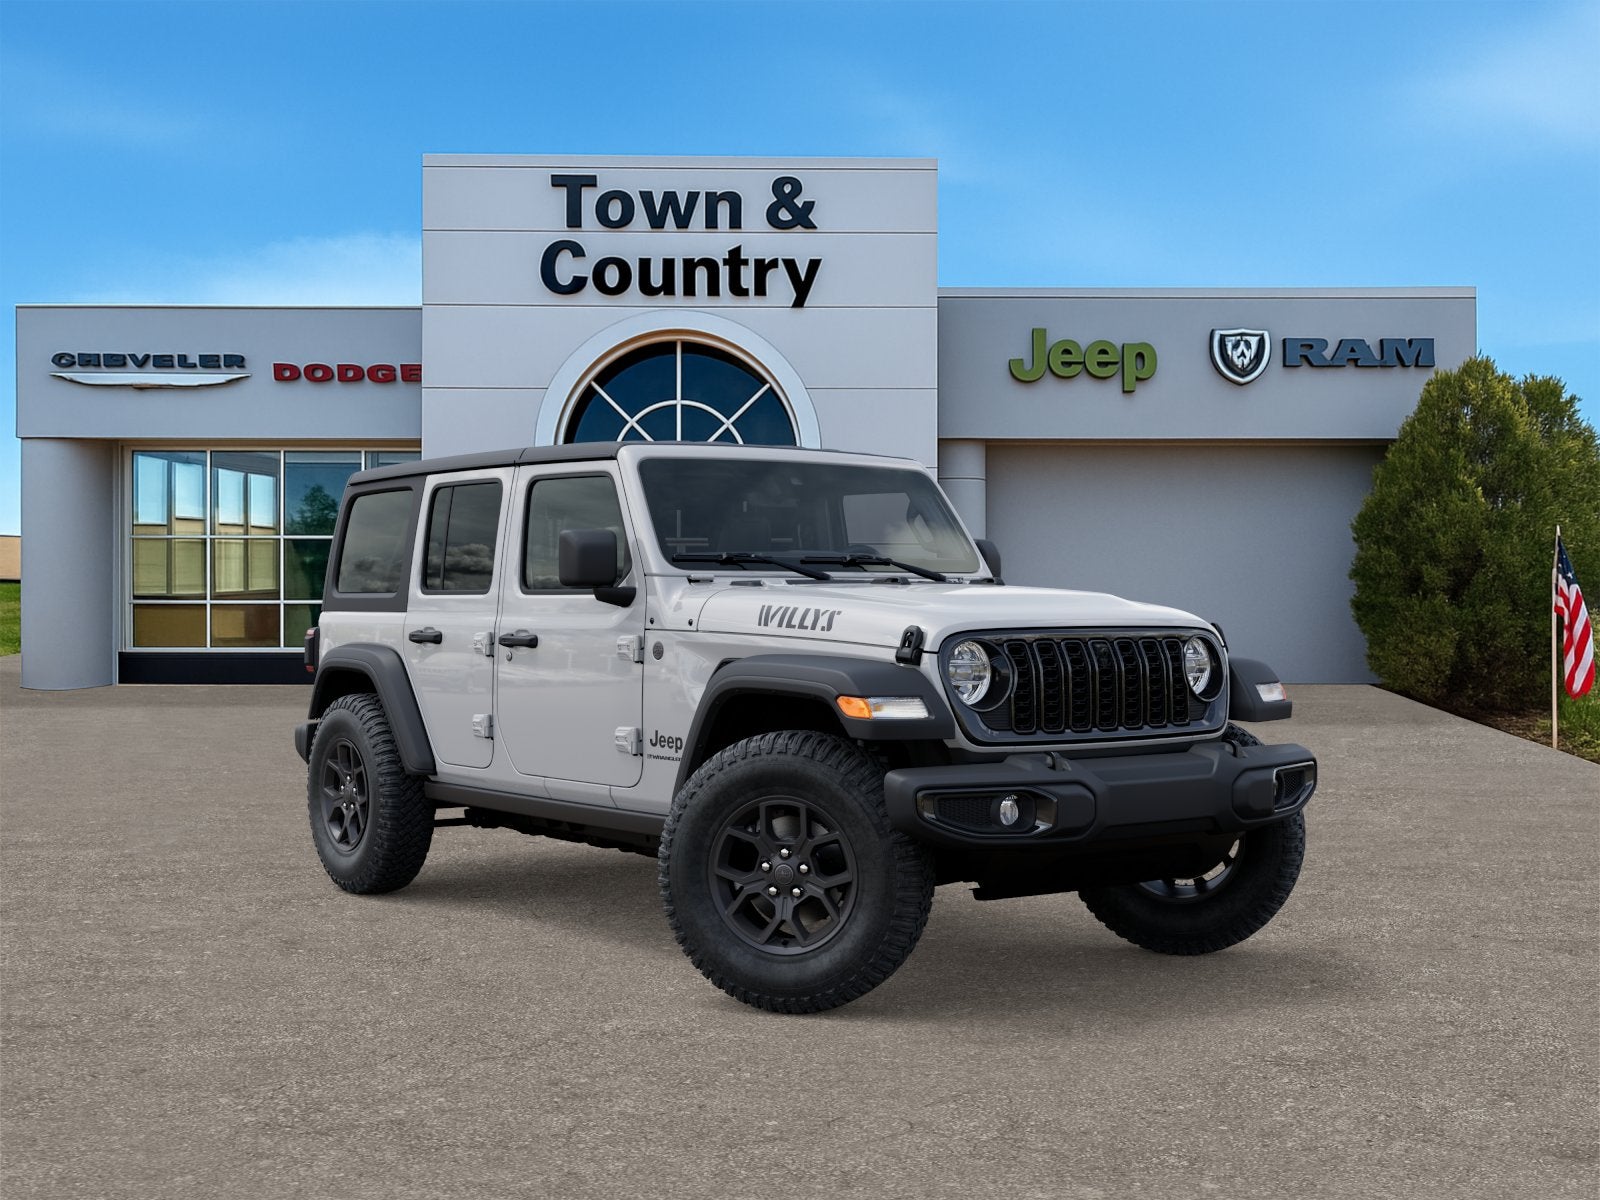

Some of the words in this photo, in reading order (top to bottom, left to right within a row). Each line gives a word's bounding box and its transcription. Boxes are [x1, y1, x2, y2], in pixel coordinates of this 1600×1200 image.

[551, 174, 742, 229] Town
[765, 176, 818, 229] &
[540, 239, 822, 308] Country
[1009, 328, 1157, 392] Jeep
[1282, 337, 1436, 367] RAM
[272, 363, 422, 383] DODGE
[758, 605, 842, 632] WILLYS
[650, 729, 683, 753] Jeep
